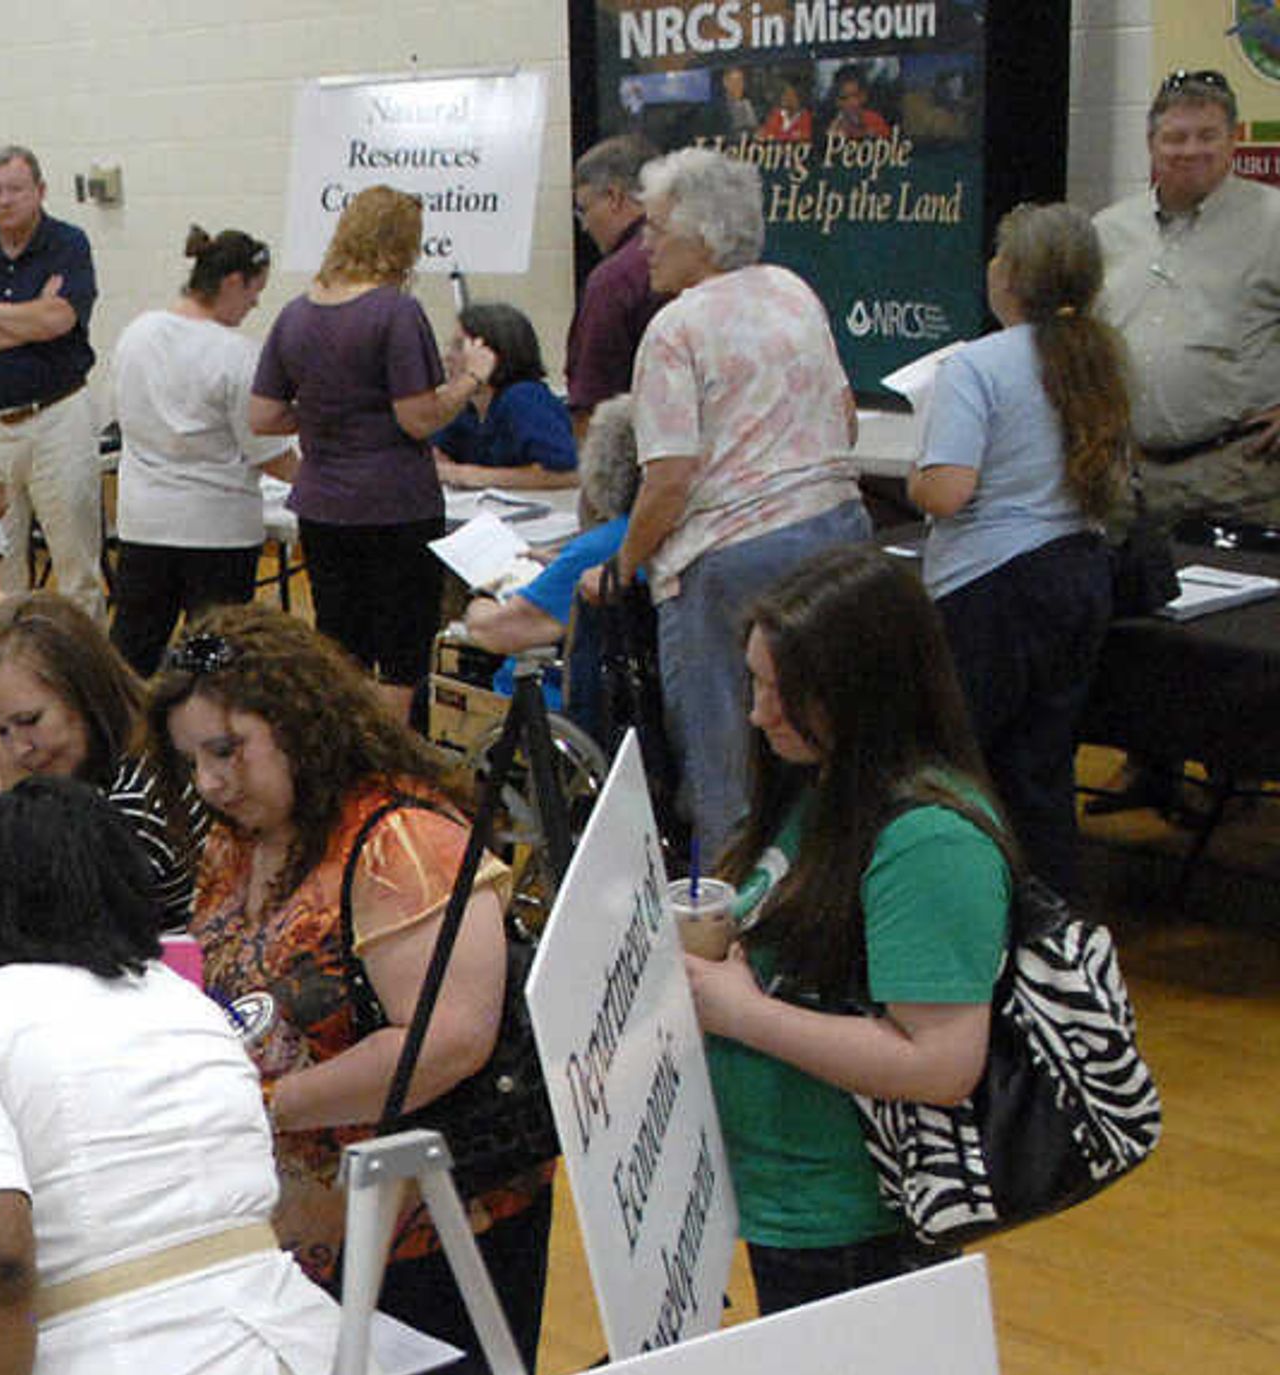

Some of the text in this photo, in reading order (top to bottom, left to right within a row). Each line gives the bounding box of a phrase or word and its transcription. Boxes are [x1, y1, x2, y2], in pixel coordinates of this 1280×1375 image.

[619, 0, 936, 59] NRCS in Missouri
[348, 139, 480, 169] Resources
[823, 124, 914, 181] People
[768, 179, 963, 234] Help the Land
[874, 299, 926, 340] NRCS
[566, 888, 651, 1154] Department
[613, 1026, 681, 1254] Economic
